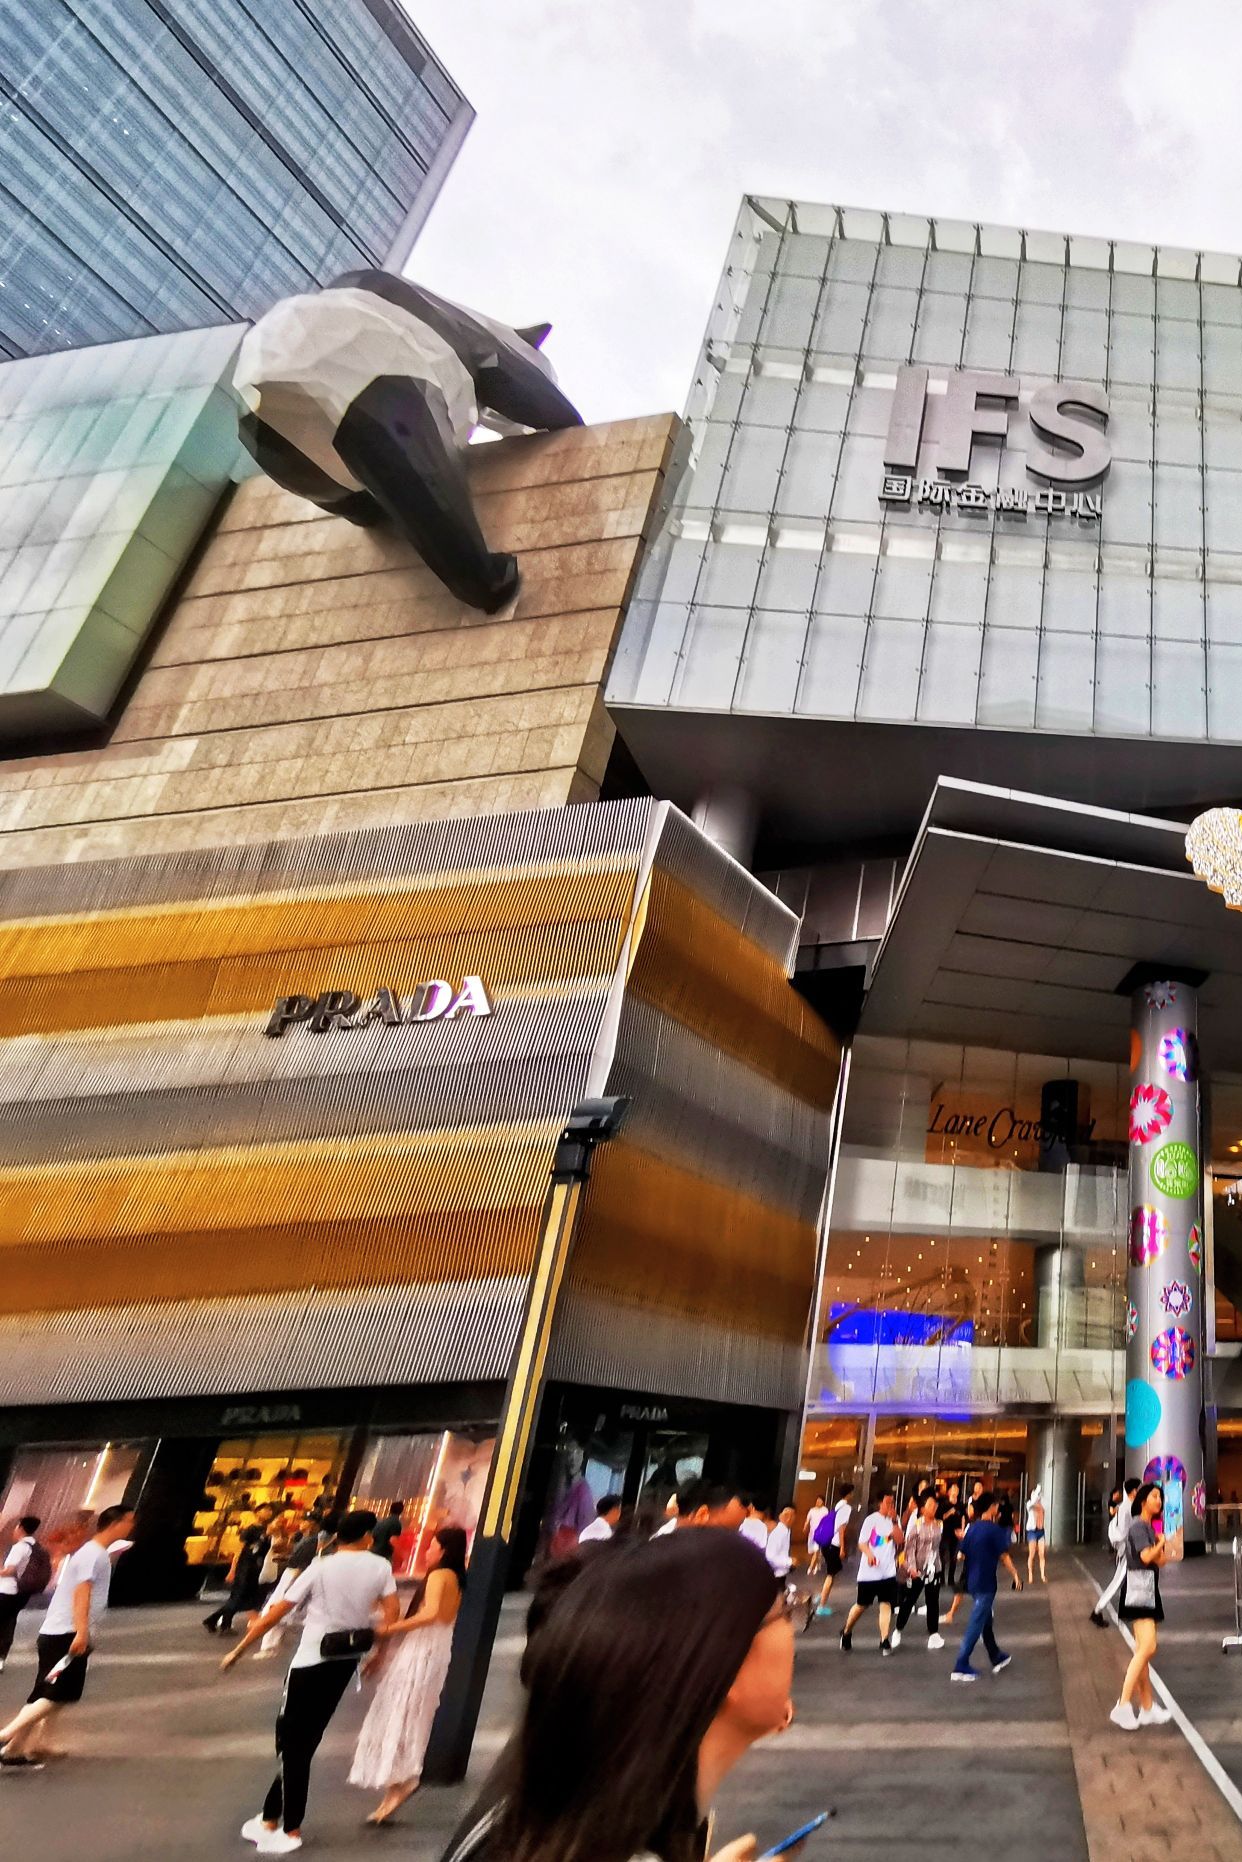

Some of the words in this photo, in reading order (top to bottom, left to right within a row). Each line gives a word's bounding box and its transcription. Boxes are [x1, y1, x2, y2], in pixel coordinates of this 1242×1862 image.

[883, 365, 1113, 490] IFS
[878, 474, 1103, 518] 国际金融中心
[264, 975, 493, 1039] PRADA
[926, 1104, 988, 1137] Lane
[986, 1107, 1096, 1149] Craw
[620, 1404, 669, 1421] PRADA
